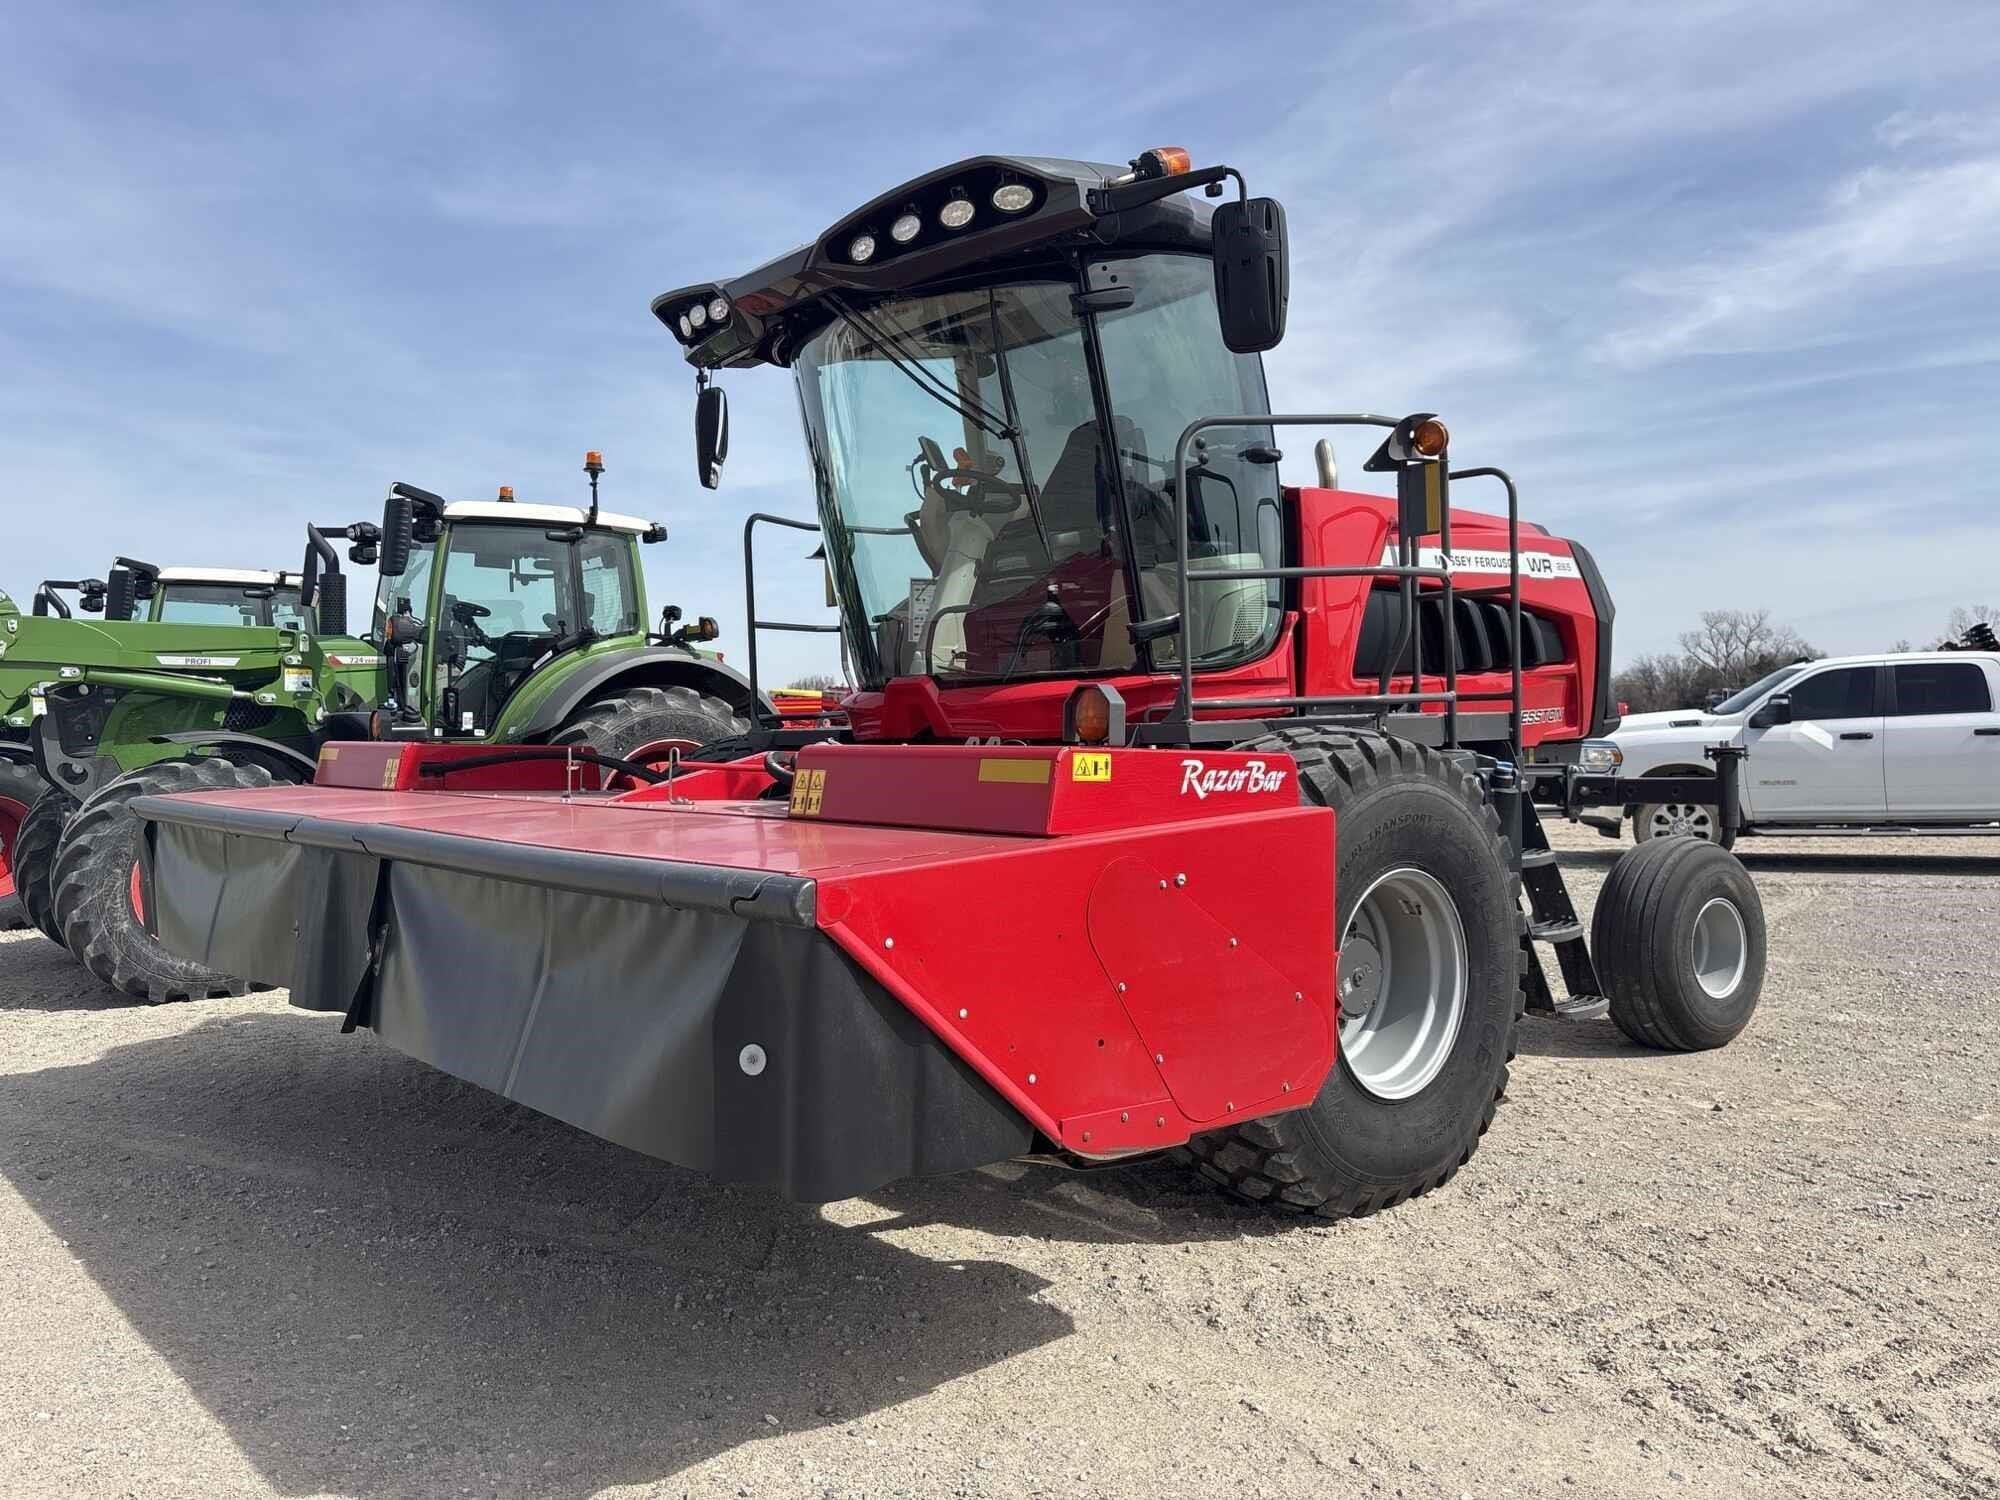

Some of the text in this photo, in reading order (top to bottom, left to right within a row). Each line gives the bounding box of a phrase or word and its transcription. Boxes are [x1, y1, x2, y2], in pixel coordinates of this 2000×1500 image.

[1434, 555, 1471, 568] MSSEY
[1474, 557, 1511, 570] FERGUSO
[1526, 556, 1553, 574] WR
[1520, 706, 1564, 725] ESSTON
[1180, 759, 1288, 800] RazorBar
